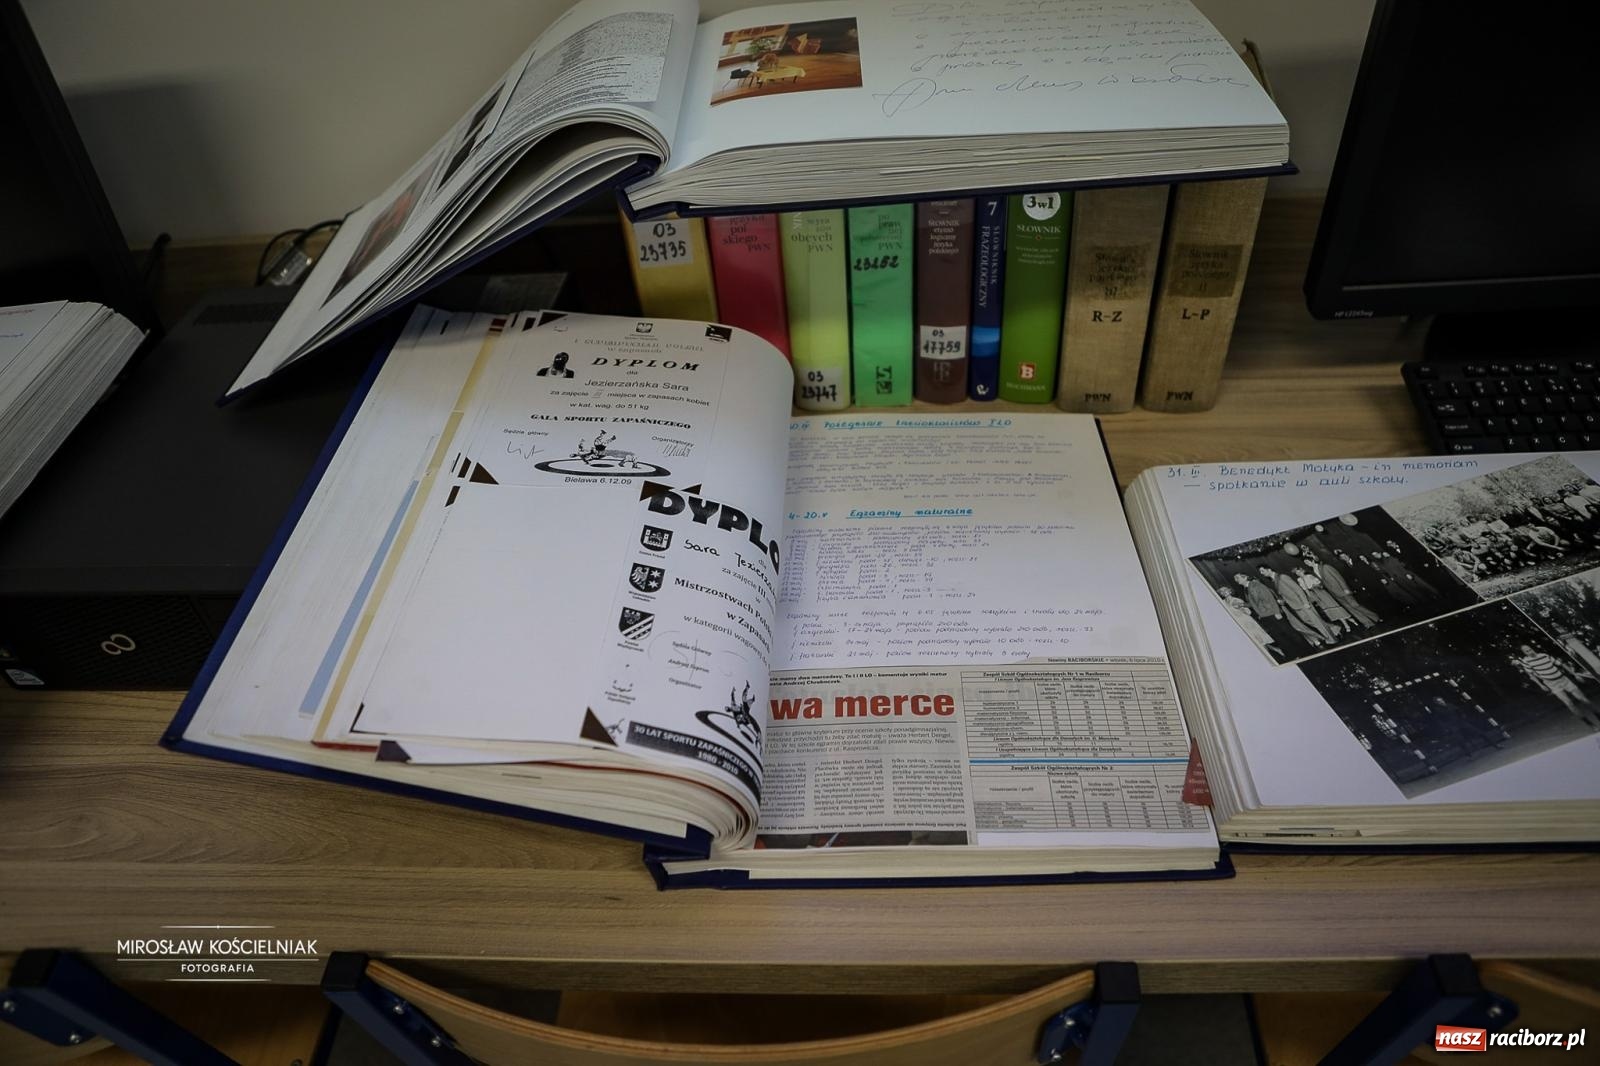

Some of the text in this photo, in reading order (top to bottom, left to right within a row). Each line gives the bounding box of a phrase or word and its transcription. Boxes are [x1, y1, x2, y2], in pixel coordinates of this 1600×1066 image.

[986, 200, 998, 217] 7
[652, 222, 677, 238] 03
[1015, 224, 1062, 234] SŁOWNIK
[640, 240, 687, 262] 23735
[923, 340, 962, 355] 17759
[591, 356, 700, 372] DYPLOM
[807, 370, 825, 382] 03
[584, 379, 690, 392] Jezierzańska Sara
[647, 393, 685, 403] zapasach
[1084, 392, 1112, 402] PWN
[1165, 390, 1194, 402] PWN
[639, 404, 650, 412] kg
[530, 413, 692, 430] GALA SPORTU ZAPAŚNICZEGO
[1302, 461, 1355, 474] Motyka
[564, 476, 632, 485] Bielawa 6.12.09
[1295, 479, 1309, 488] w
[849, 508, 902, 519] Egzaminy
[914, 507, 974, 517] maturalne
[684, 539, 720, 557] Sara
[674, 577, 754, 615] Mistrzostwach
[726, 611, 737, 621] w
[683, 614, 693, 623] w
[693, 616, 734, 636] kategorii
[833, 692, 956, 720] merce
[633, 725, 645, 735] 30
[645, 727, 662, 739] LAT
[662, 731, 697, 747] SPORTU
